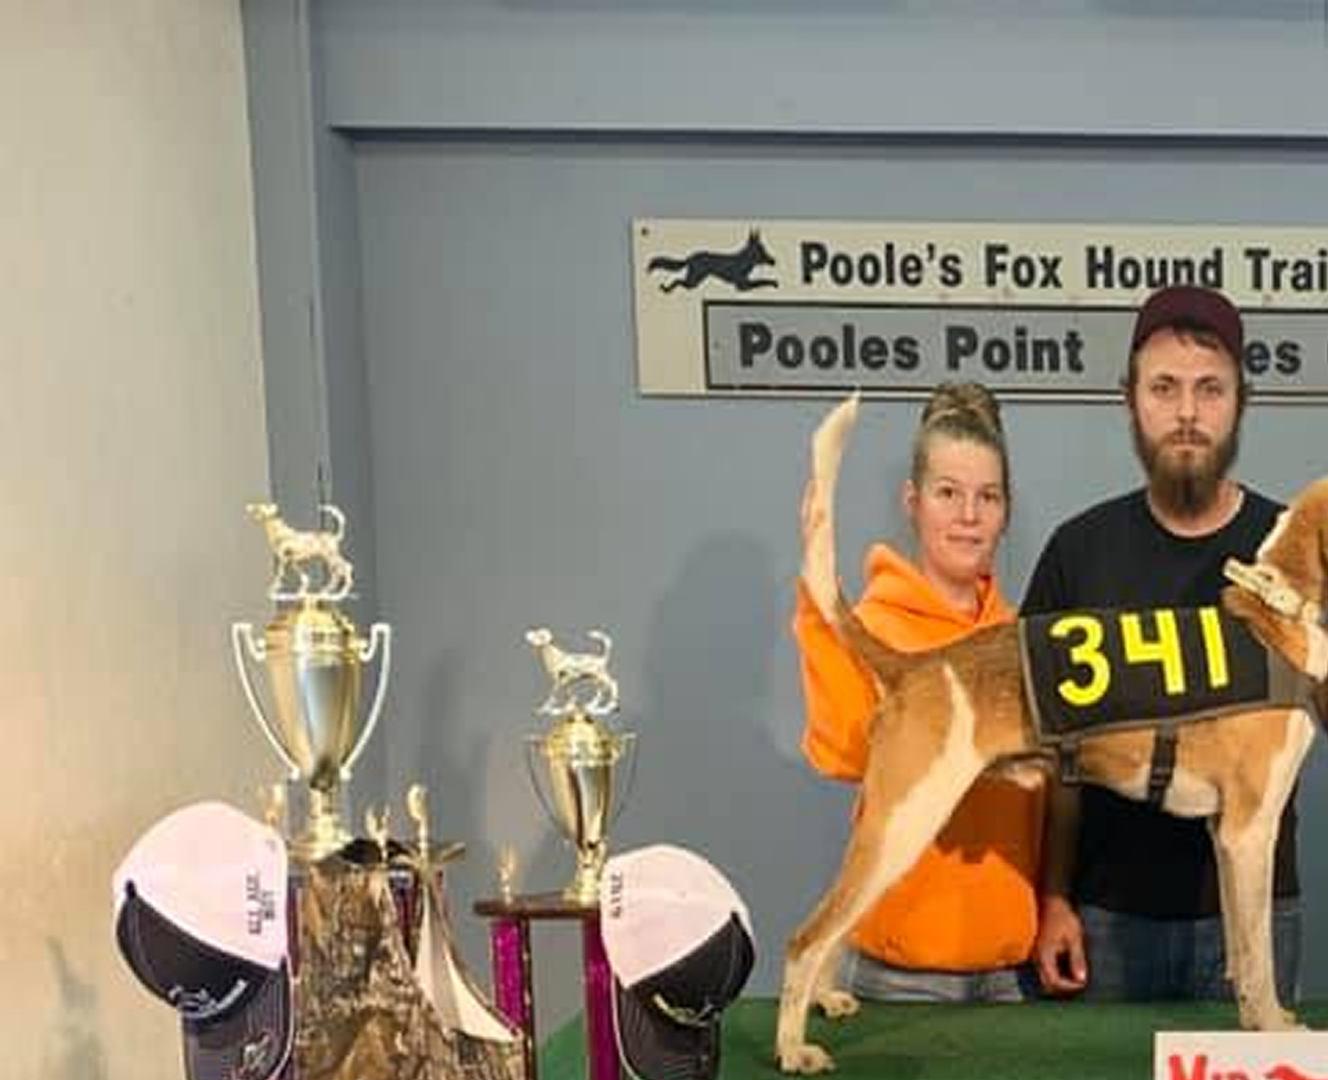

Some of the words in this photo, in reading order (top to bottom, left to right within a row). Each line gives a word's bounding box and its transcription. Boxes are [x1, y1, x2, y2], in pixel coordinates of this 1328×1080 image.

[801, 242, 962, 287] Poole's
[985, 245, 1062, 288] Fox
[1086, 247, 1223, 290] Hound
[740, 323, 919, 370] Pooles
[946, 326, 1085, 372] Point
[1050, 606, 1229, 706] 341
